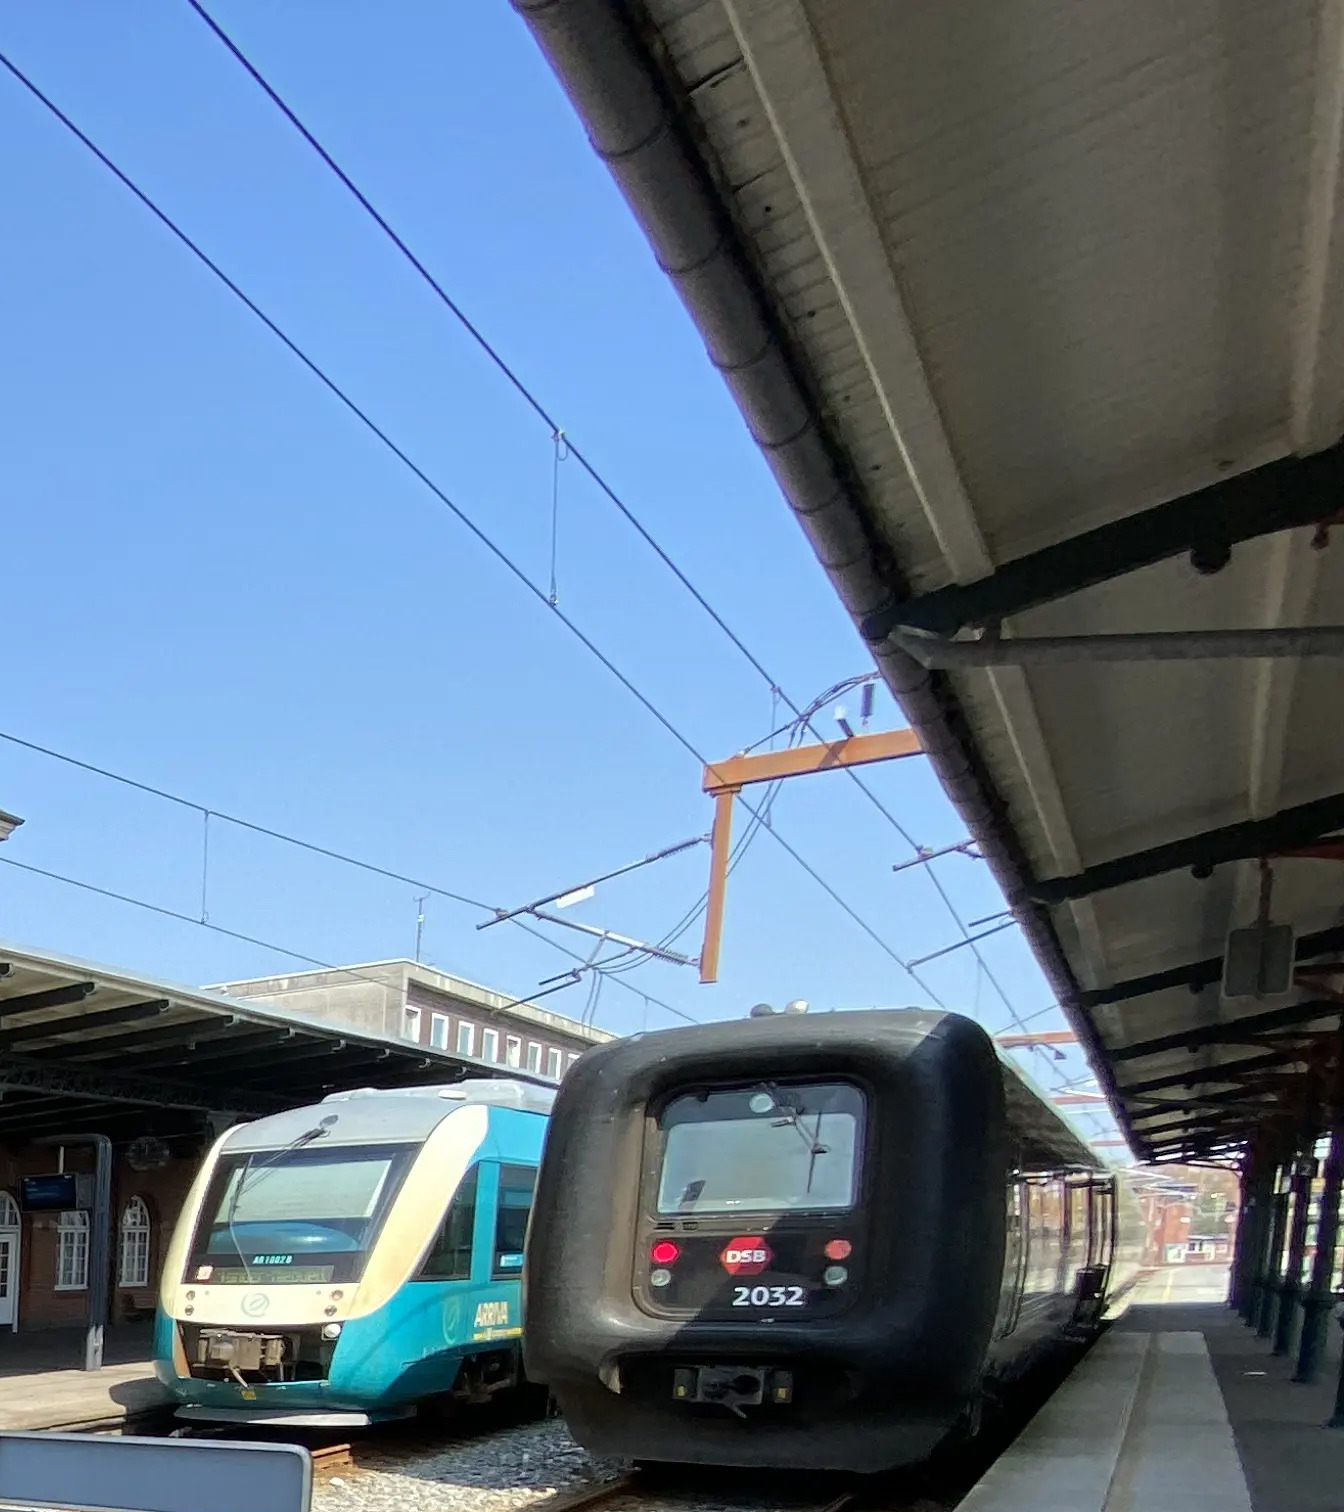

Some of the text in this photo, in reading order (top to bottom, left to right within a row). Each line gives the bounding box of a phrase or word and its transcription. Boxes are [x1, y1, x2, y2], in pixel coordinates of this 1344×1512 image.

[726, 1249, 766, 1264] DSB
[732, 1286, 803, 1306] 2032
[474, 1301, 508, 1328] ARRIVA
